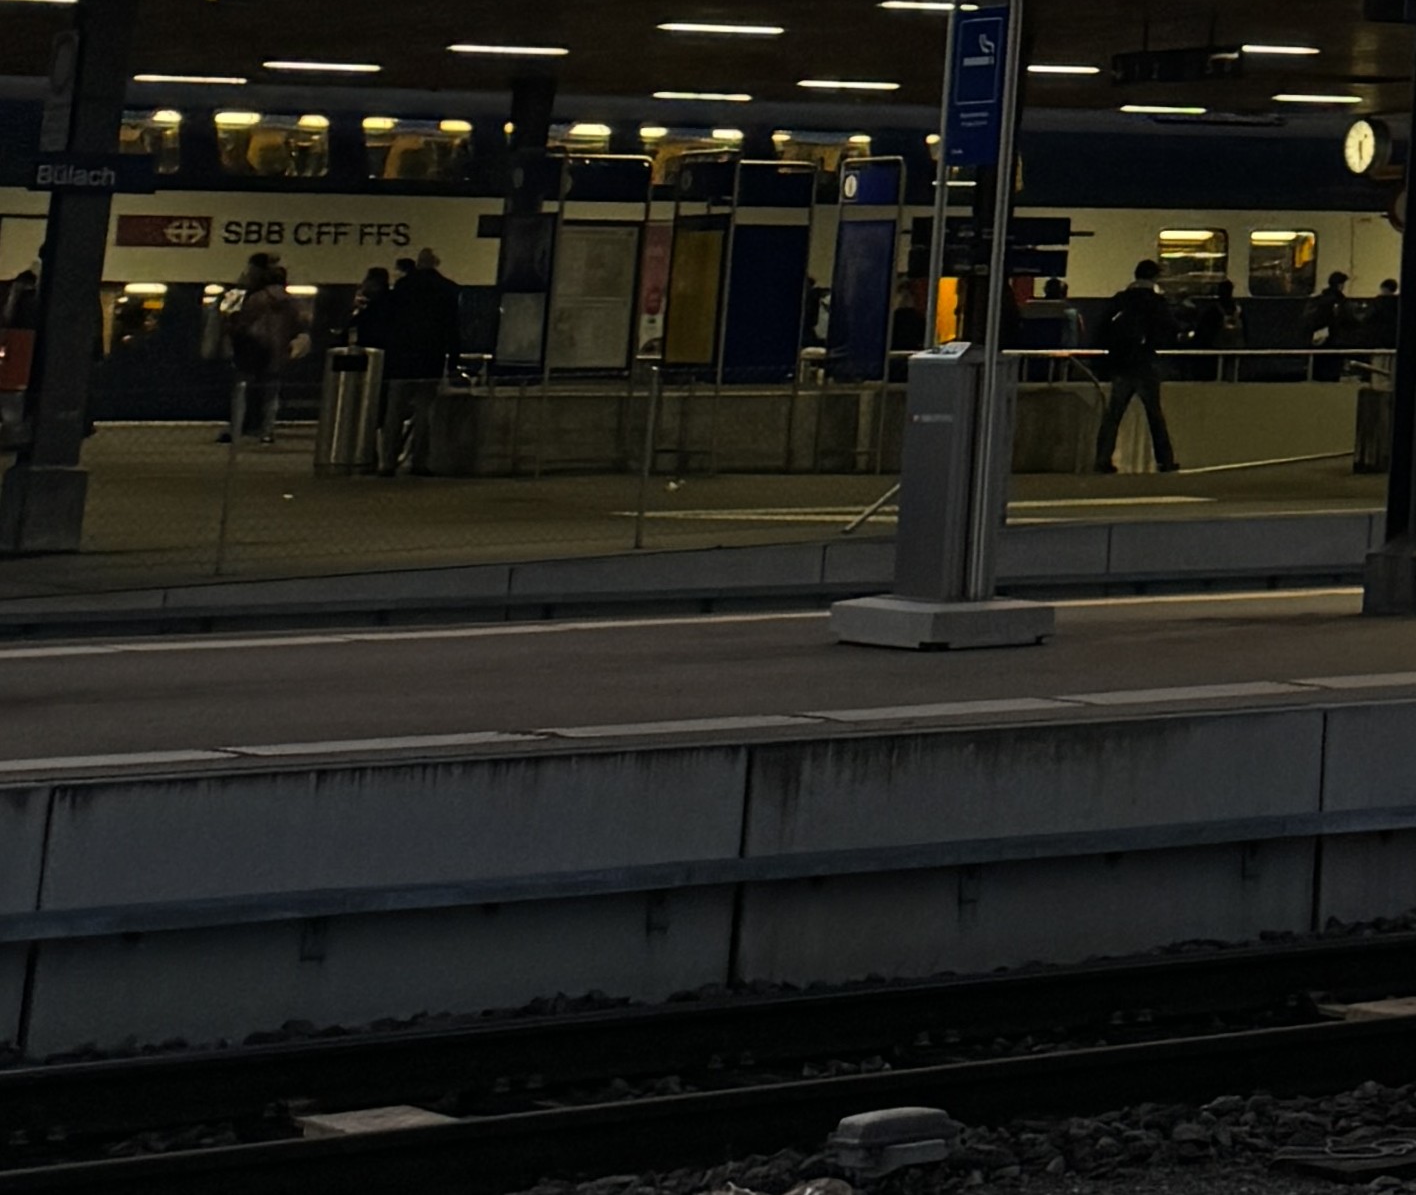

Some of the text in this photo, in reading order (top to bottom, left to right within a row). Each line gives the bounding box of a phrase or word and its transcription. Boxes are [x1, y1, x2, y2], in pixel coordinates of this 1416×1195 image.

[36, 164, 116, 187] Bülach
[224, 221, 411, 247] SBB CFF FFS
